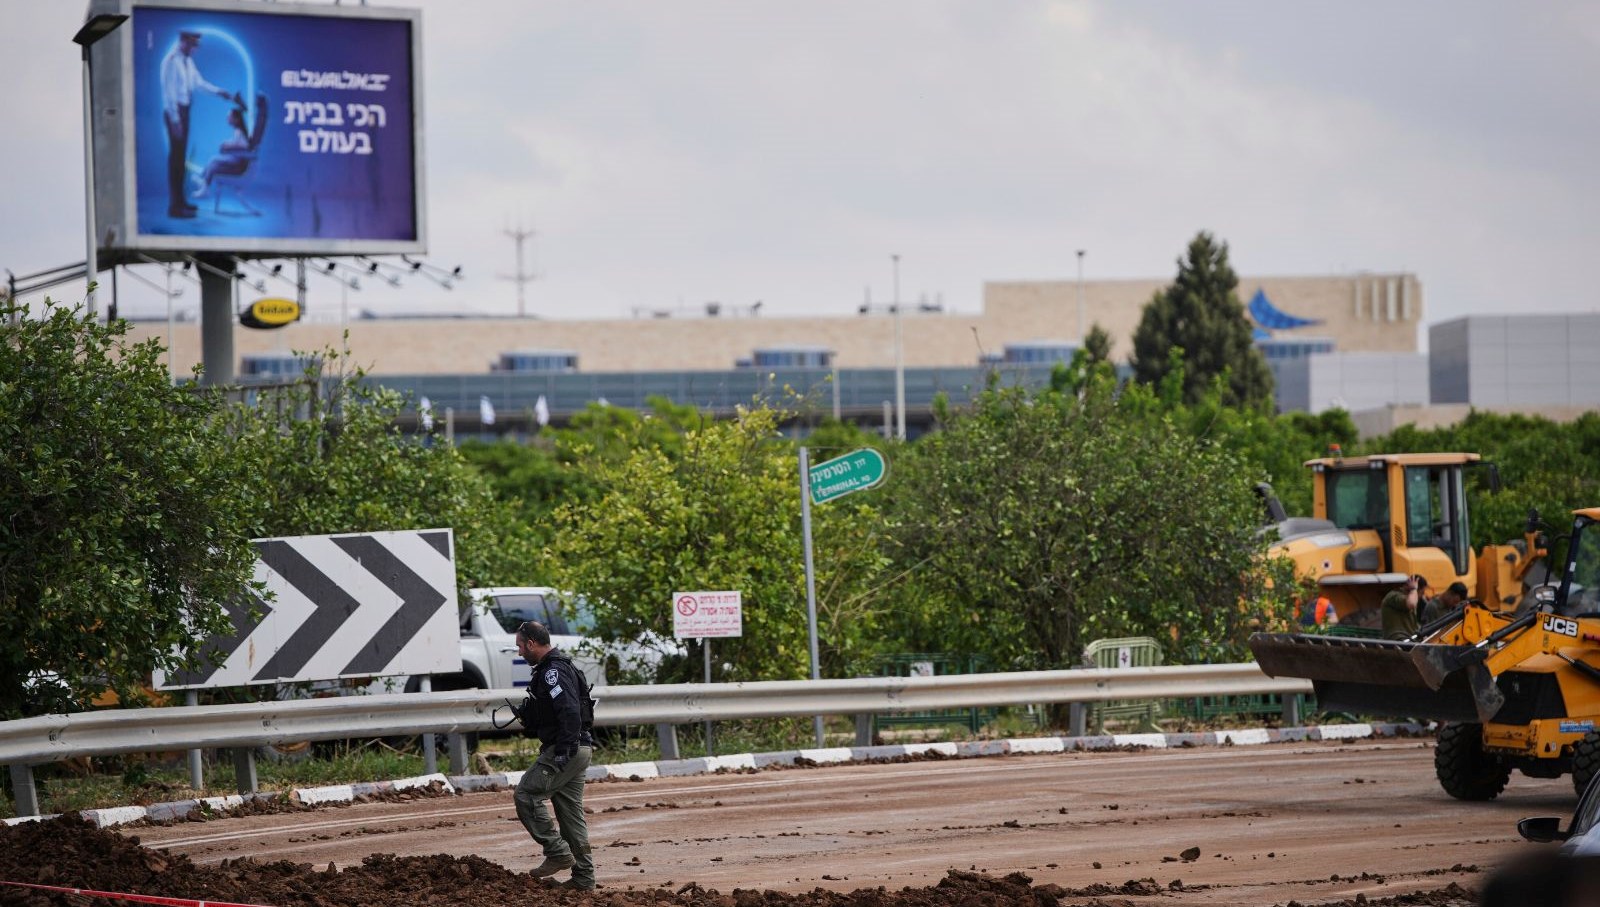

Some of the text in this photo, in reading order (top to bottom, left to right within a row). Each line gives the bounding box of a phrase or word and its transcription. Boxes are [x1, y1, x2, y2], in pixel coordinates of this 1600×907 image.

[284, 101, 387, 127] הכי בבית
[298, 128, 373, 154] בעולם
[816, 477, 860, 497] TERMINAL
[1543, 616, 1578, 636] JCB
